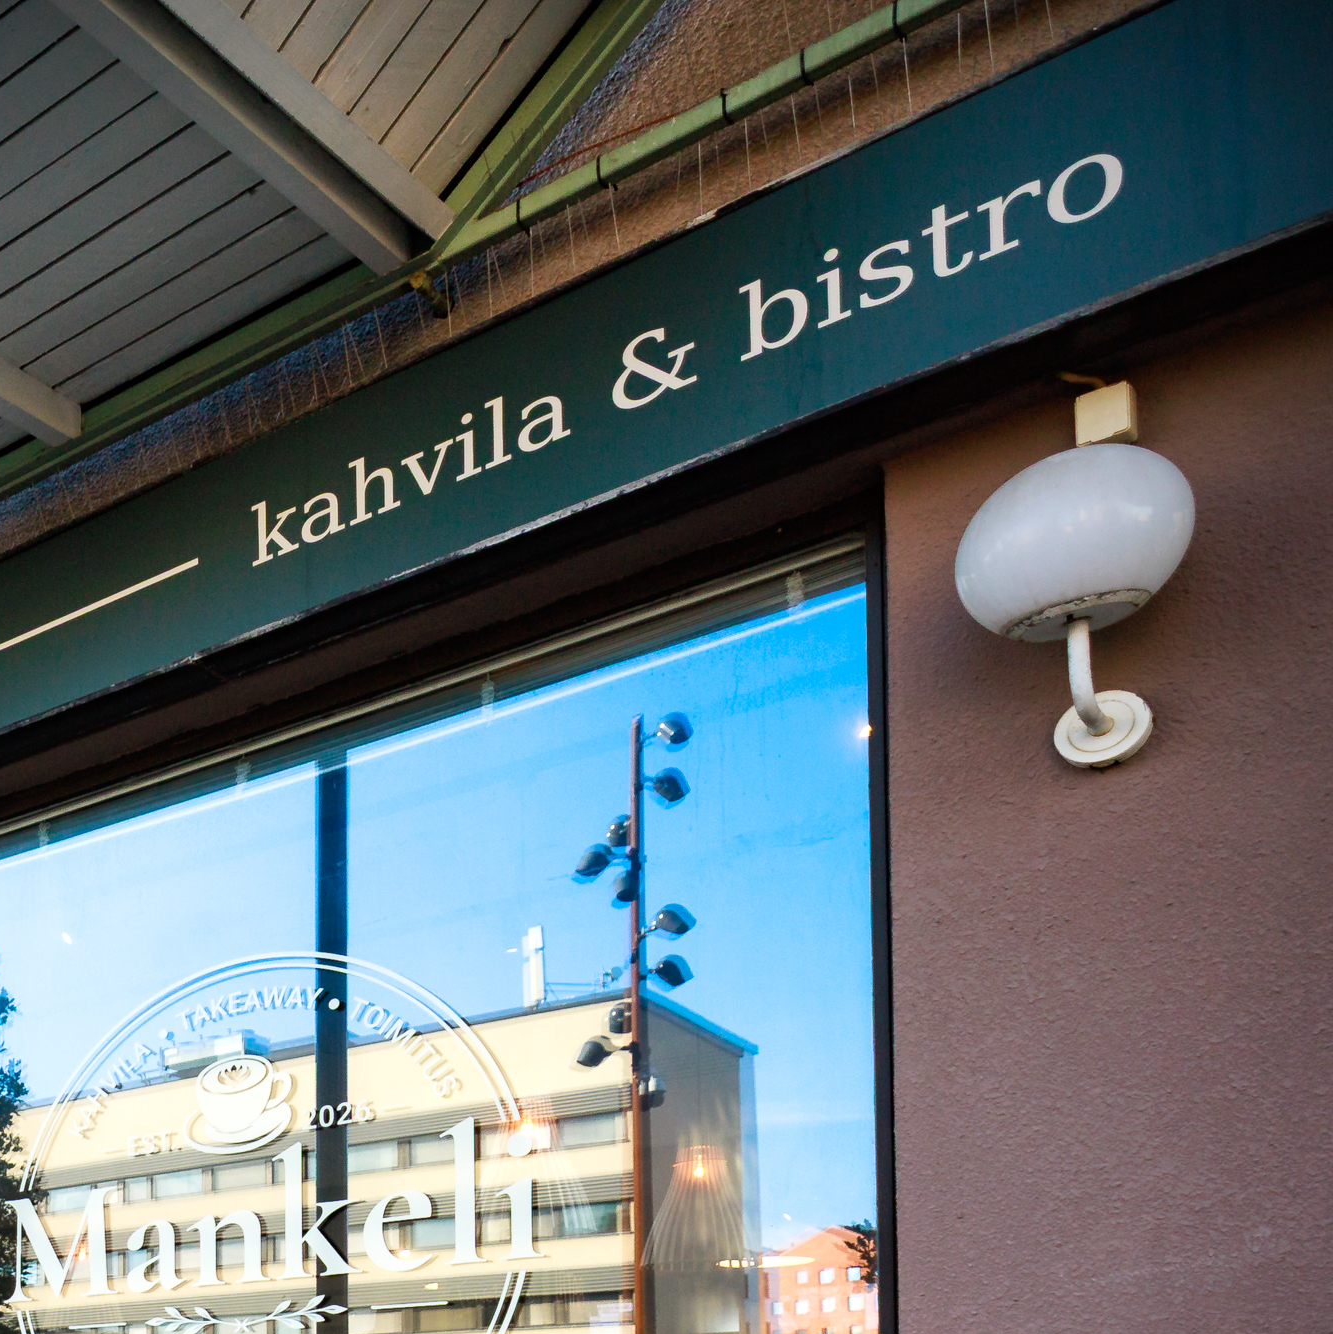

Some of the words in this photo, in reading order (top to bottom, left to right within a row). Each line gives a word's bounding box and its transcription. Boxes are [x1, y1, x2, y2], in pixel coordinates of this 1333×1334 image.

[251, 396, 571, 567] kahvila
[612, 327, 698, 411] &
[741, 152, 1125, 363] bistro
[68, 1041, 157, 1140] KAHVILA
[175, 985, 324, 1031] TAKEAWAY
[350, 997, 462, 1099] TOIMITUS
[127, 1131, 180, 1156] EST.
[302, 1100, 371, 1132] 2026
[5, 1116, 546, 1304] Mankeli
